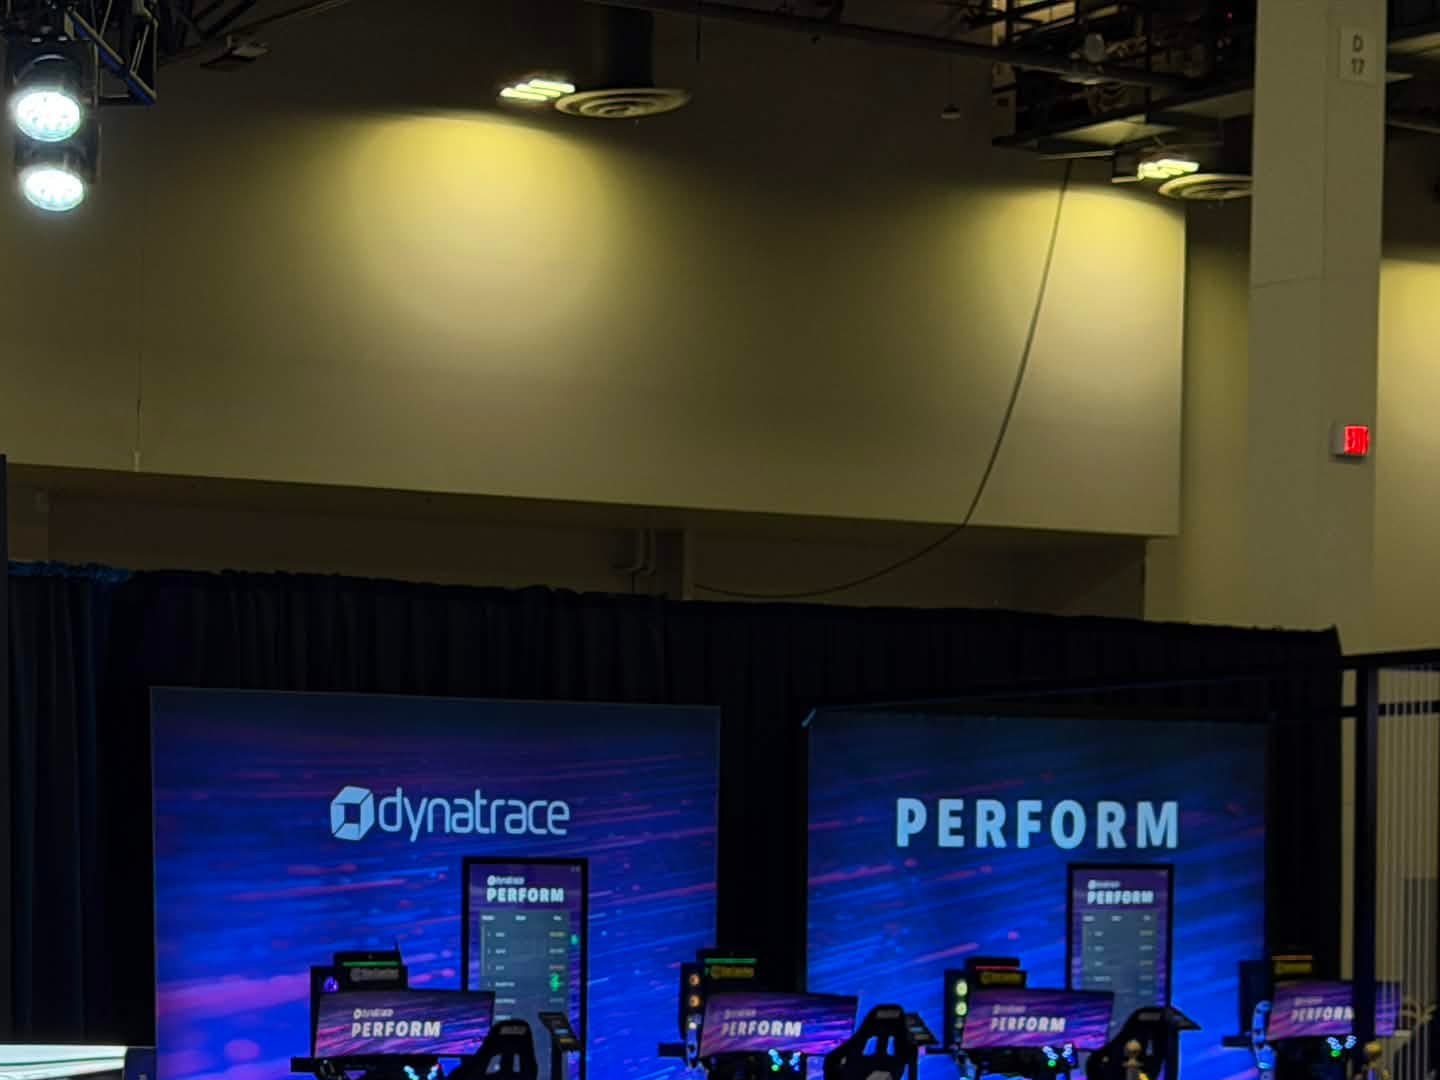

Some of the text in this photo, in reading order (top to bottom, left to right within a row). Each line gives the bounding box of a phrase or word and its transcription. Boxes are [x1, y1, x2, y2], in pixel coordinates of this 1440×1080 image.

[379, 787, 570, 842] dynatrace
[897, 798, 1179, 850] PERFORM
[487, 888, 565, 902] PERFORM
[351, 1021, 441, 1037] PERFORM
[722, 1020, 802, 1037] PERFORM
[991, 1017, 1066, 1032] PERFORM
